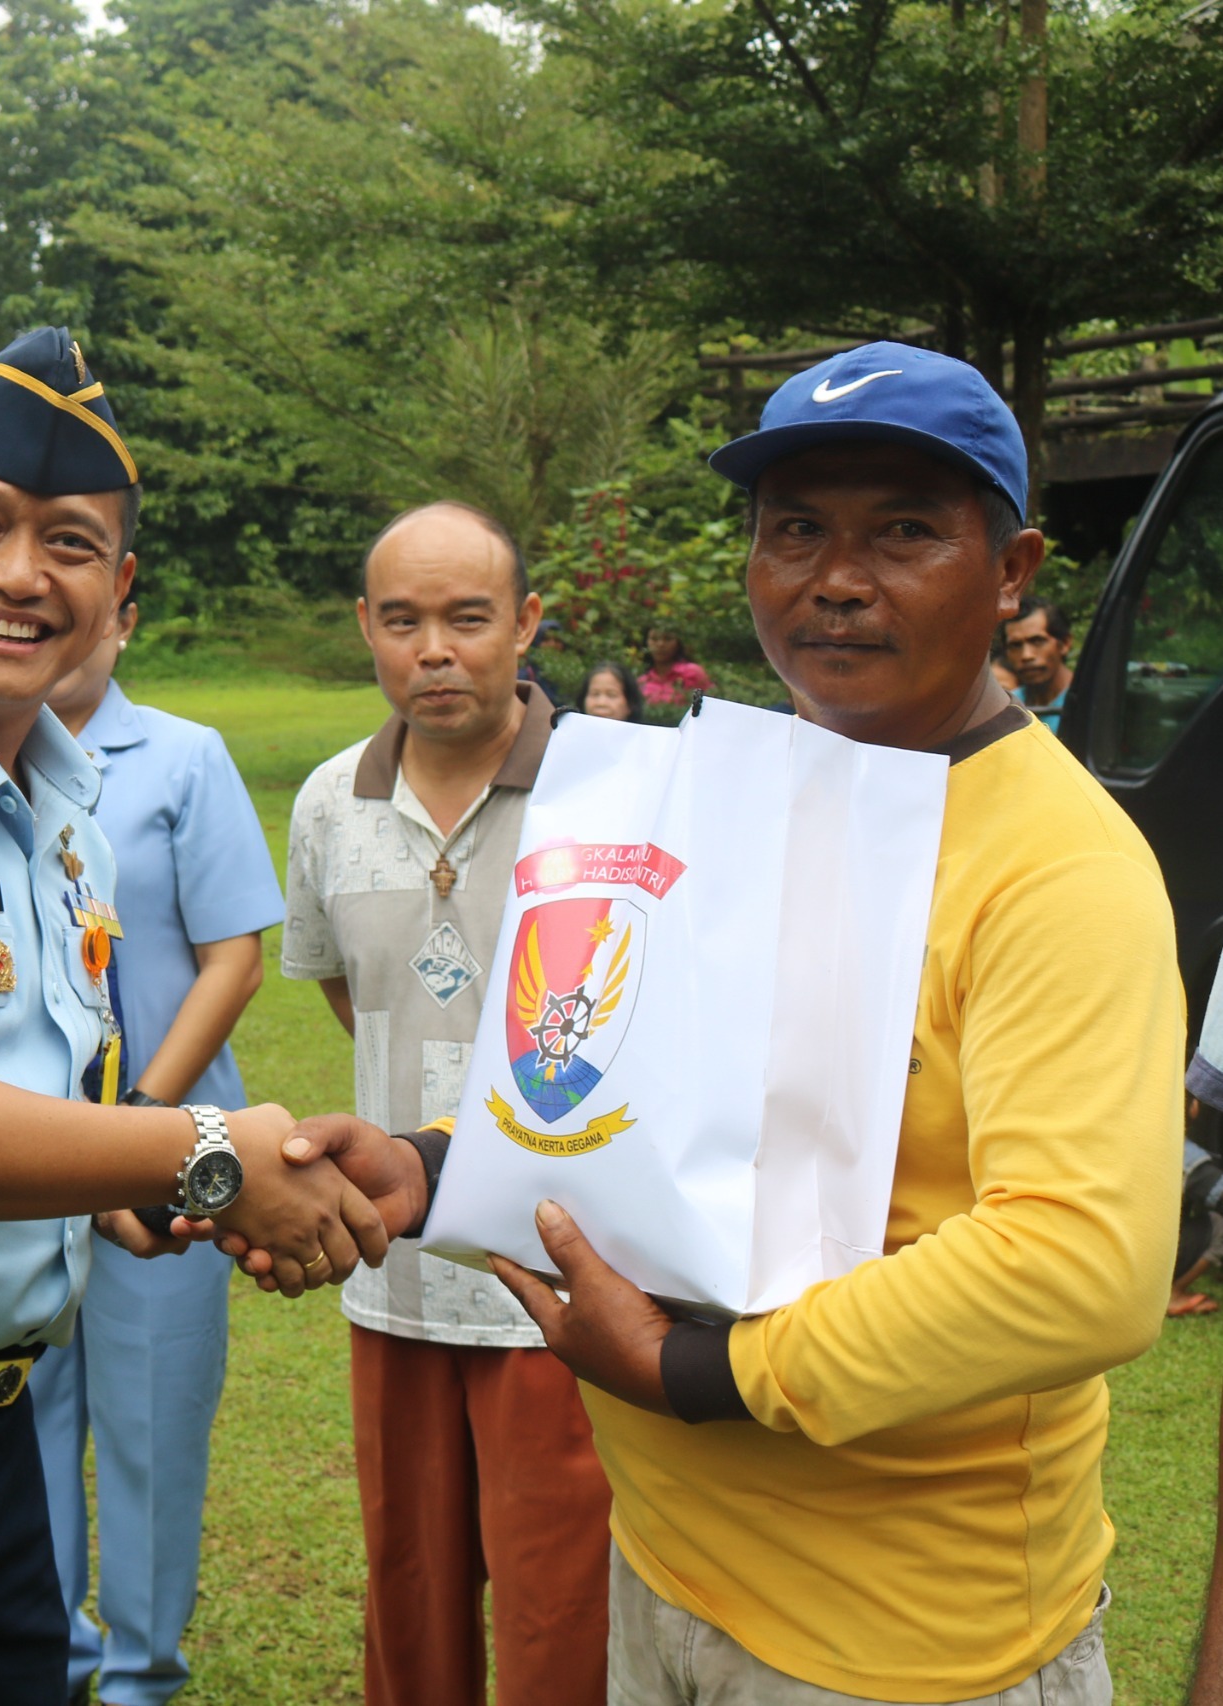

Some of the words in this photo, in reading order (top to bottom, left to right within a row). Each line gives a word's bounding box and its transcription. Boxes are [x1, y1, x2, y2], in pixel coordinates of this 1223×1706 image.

[502, 1117, 537, 1148] PRAYATNA
[538, 1138, 565, 1152] KERTA
[566, 1132, 604, 1153] GEGANA
